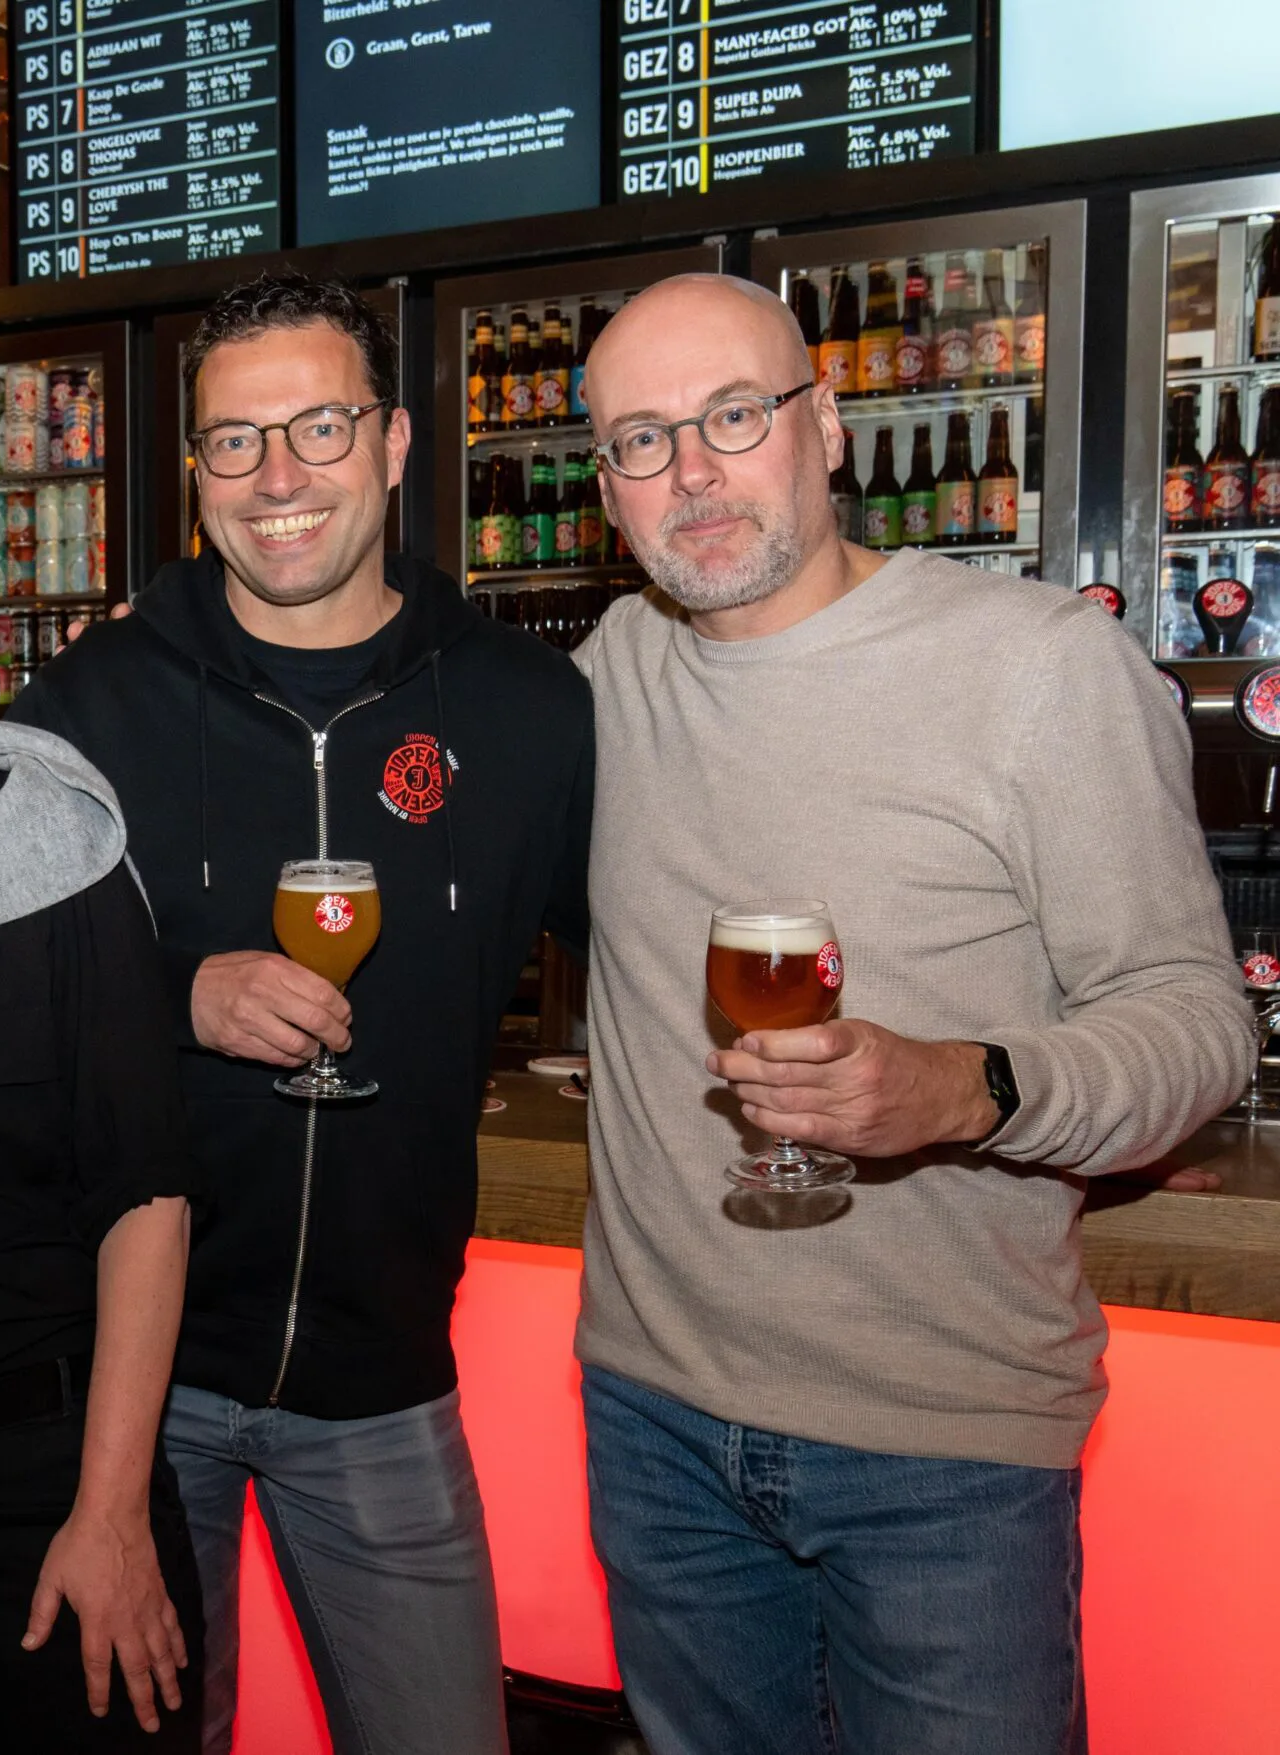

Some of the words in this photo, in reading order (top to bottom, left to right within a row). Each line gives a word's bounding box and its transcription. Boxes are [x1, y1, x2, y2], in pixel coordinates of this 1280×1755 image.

[25, 5, 48, 34] PS
[60, 0, 72, 26] 5
[323, 0, 389, 23] Bitterheid:
[623, 0, 668, 24] GEZ
[849, 16, 878, 32] Alc.
[883, 7, 916, 27] 10%
[918, 3, 948, 20] Vol.
[186, 29, 207, 42] Alc.
[210, 24, 229, 38] 5%
[230, 19, 252, 33] Vol.
[366, 38, 408, 55] Graan,
[411, 29, 449, 46] Gerst,
[452, 21, 492, 39] Tarwe
[714, 24, 810, 53] MANY-FACED
[813, 16, 848, 36] GOT
[87, 38, 138, 60] ADRIAAN
[140, 33, 162, 49] WIT
[26, 55, 48, 83] PS
[60, 50, 73, 76] 6
[623, 46, 668, 81] GEZ
[677, 41, 694, 73] 8
[115, 84, 129, 97] De
[131, 77, 164, 93] Goede
[186, 81, 208, 94] Alc.
[230, 71, 252, 84] Vol.
[848, 77, 877, 92] Alc.
[880, 67, 920, 87] 5.5%
[922, 62, 952, 79] Vol.
[714, 90, 760, 111] SUPER
[762, 83, 803, 104] DUPA
[26, 104, 49, 132] PS
[61, 99, 73, 125] 7
[623, 103, 668, 138] GEZ
[677, 99, 694, 130] 9
[714, 110, 739, 123] Dutch
[741, 107, 759, 119] Pale
[760, 105, 776, 117] Ale
[88, 128, 161, 151] ONGELOVIGE
[187, 132, 208, 144] Alc.
[211, 125, 236, 140] 10%
[238, 121, 260, 135] Vol.
[327, 124, 368, 144] Smaak
[847, 136, 876, 152] Alc.
[879, 127, 919, 147] 6.8%
[922, 123, 950, 140] Vol.
[27, 153, 50, 180] PS
[61, 148, 74, 175] 8
[88, 147, 137, 165] THOMAS
[714, 142, 806, 170] HOPPENBIER
[88, 180, 144, 200] CHERRYSH
[146, 177, 169, 192] THE
[187, 182, 208, 195] Alc.
[210, 176, 240, 191] 5.5%
[241, 172, 263, 186] Vol.
[623, 161, 668, 196] GEZ
[670, 156, 700, 188] 10
[27, 202, 50, 229] PS
[62, 198, 74, 223] 9
[88, 199, 118, 216] LOVE
[89, 238, 111, 251] Hop
[112, 235, 130, 247] On
[131, 232, 150, 245] The
[152, 228, 183, 241] Booze
[187, 233, 209, 246] Alc.
[211, 227, 240, 241] 4.8%
[241, 224, 263, 238] Vol.
[28, 250, 51, 278] PS
[57, 246, 80, 273] 10
[387, 746, 439, 779] JOPEN
[376, 788, 400, 816] NATURE
[316, 895, 348, 915] JOPEN
[320, 913, 354, 933] JOPEN
